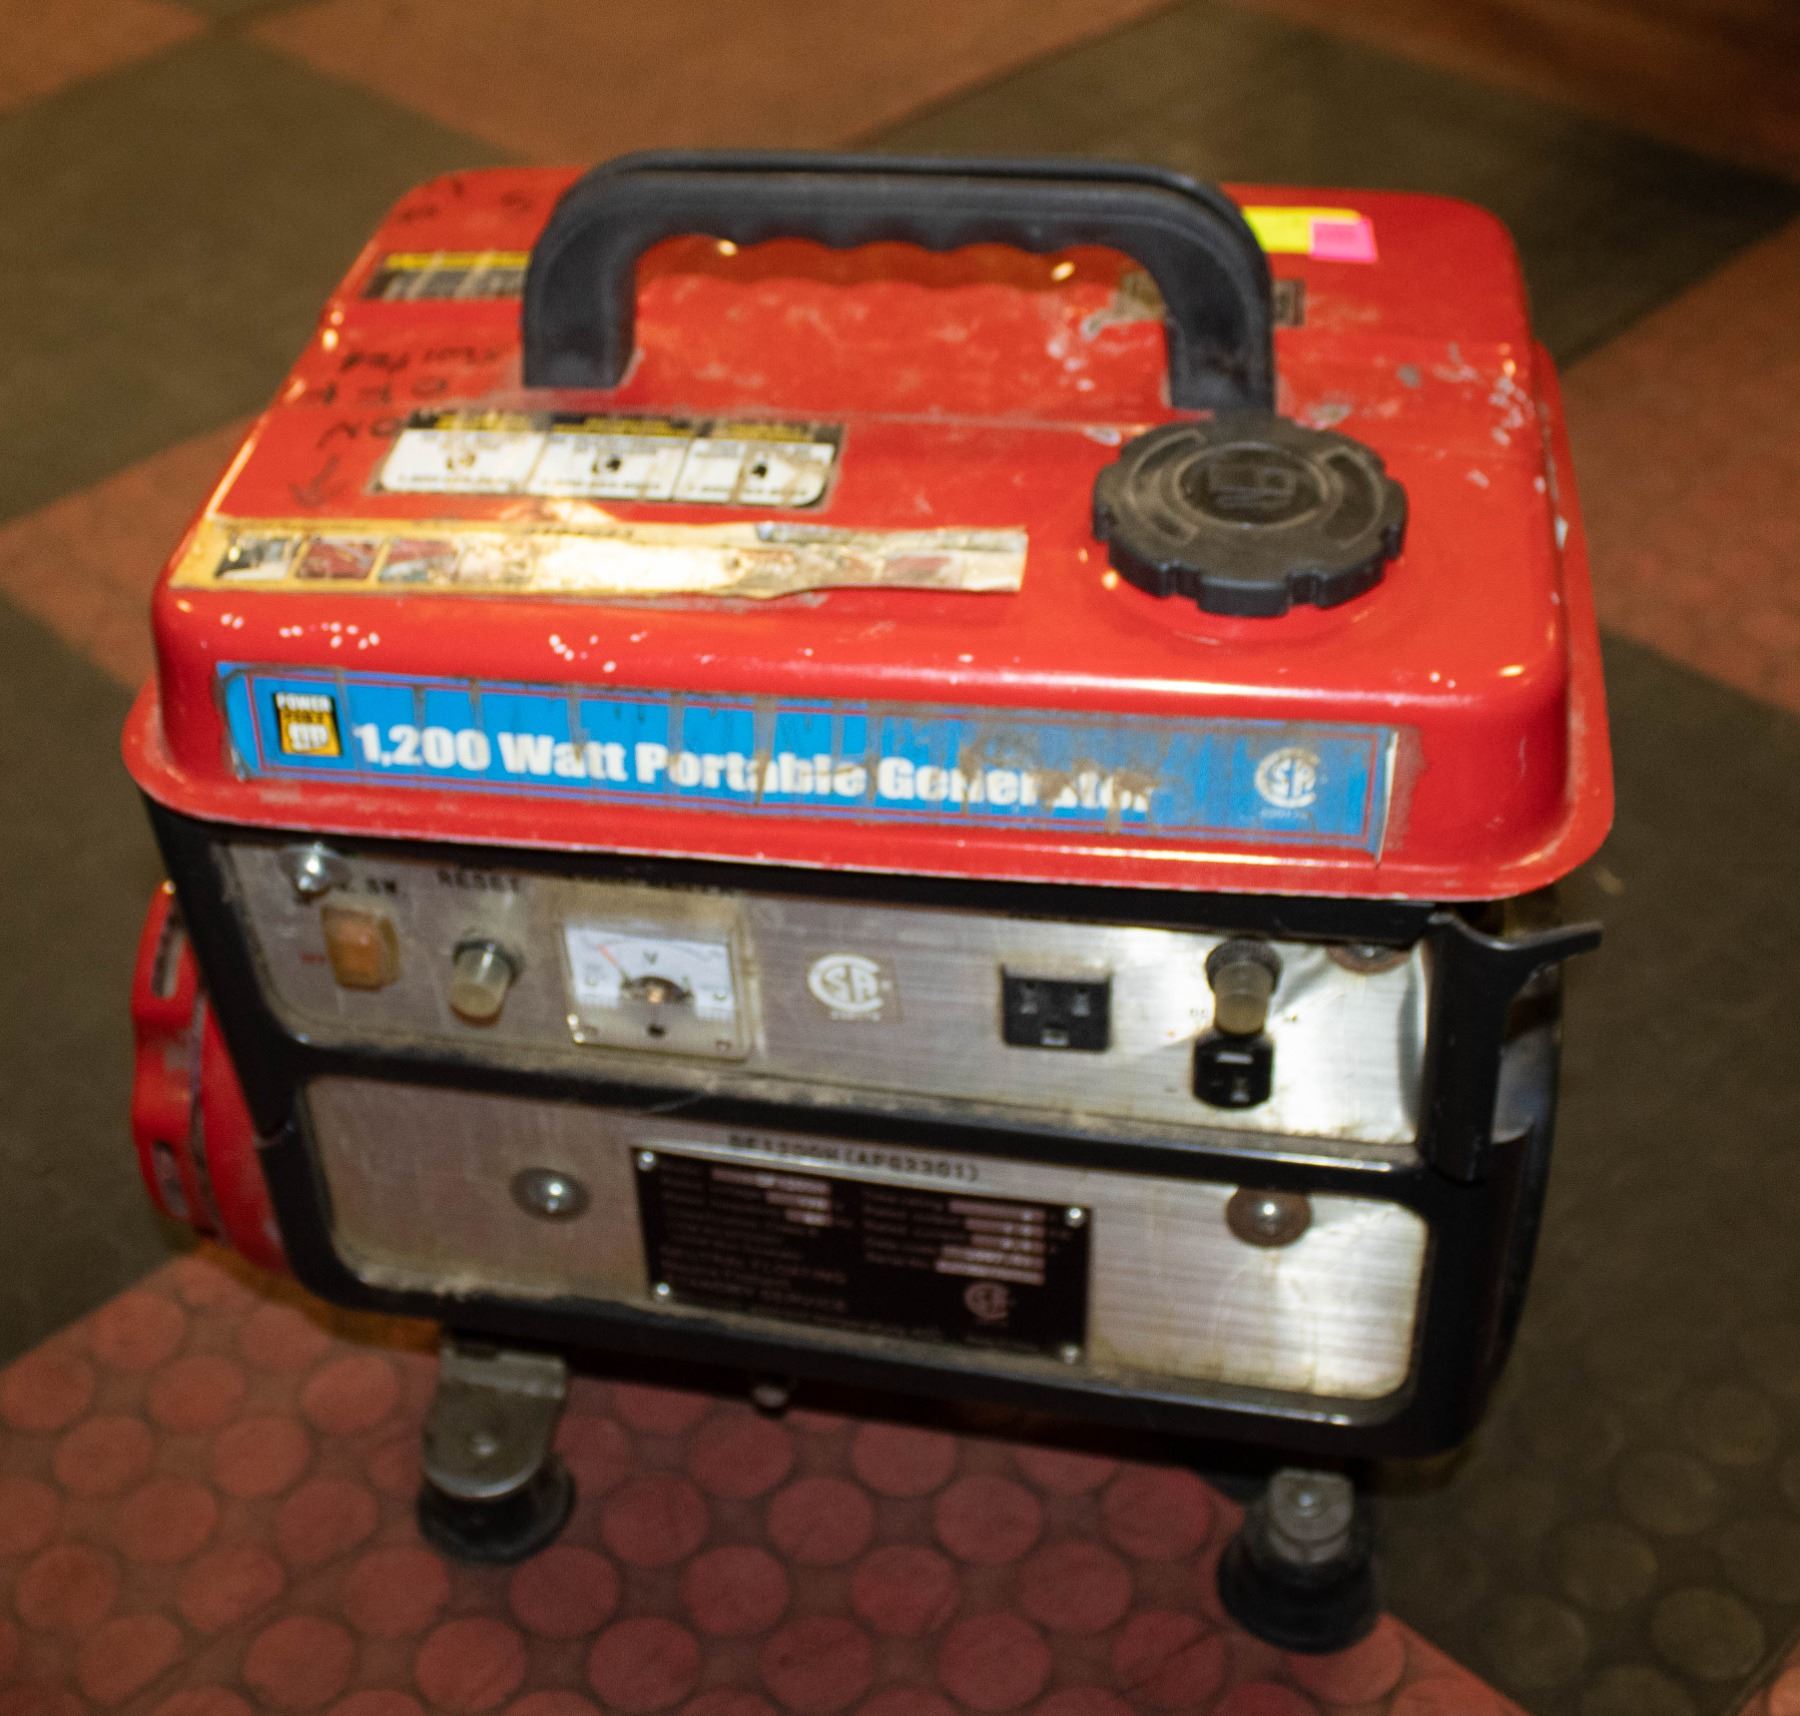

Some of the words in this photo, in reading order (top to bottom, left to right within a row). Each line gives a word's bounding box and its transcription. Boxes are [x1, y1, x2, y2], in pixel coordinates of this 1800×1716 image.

[352, 722, 491, 771] 1,200
[497, 731, 628, 782] Watt
[634, 741, 867, 797] Portable
